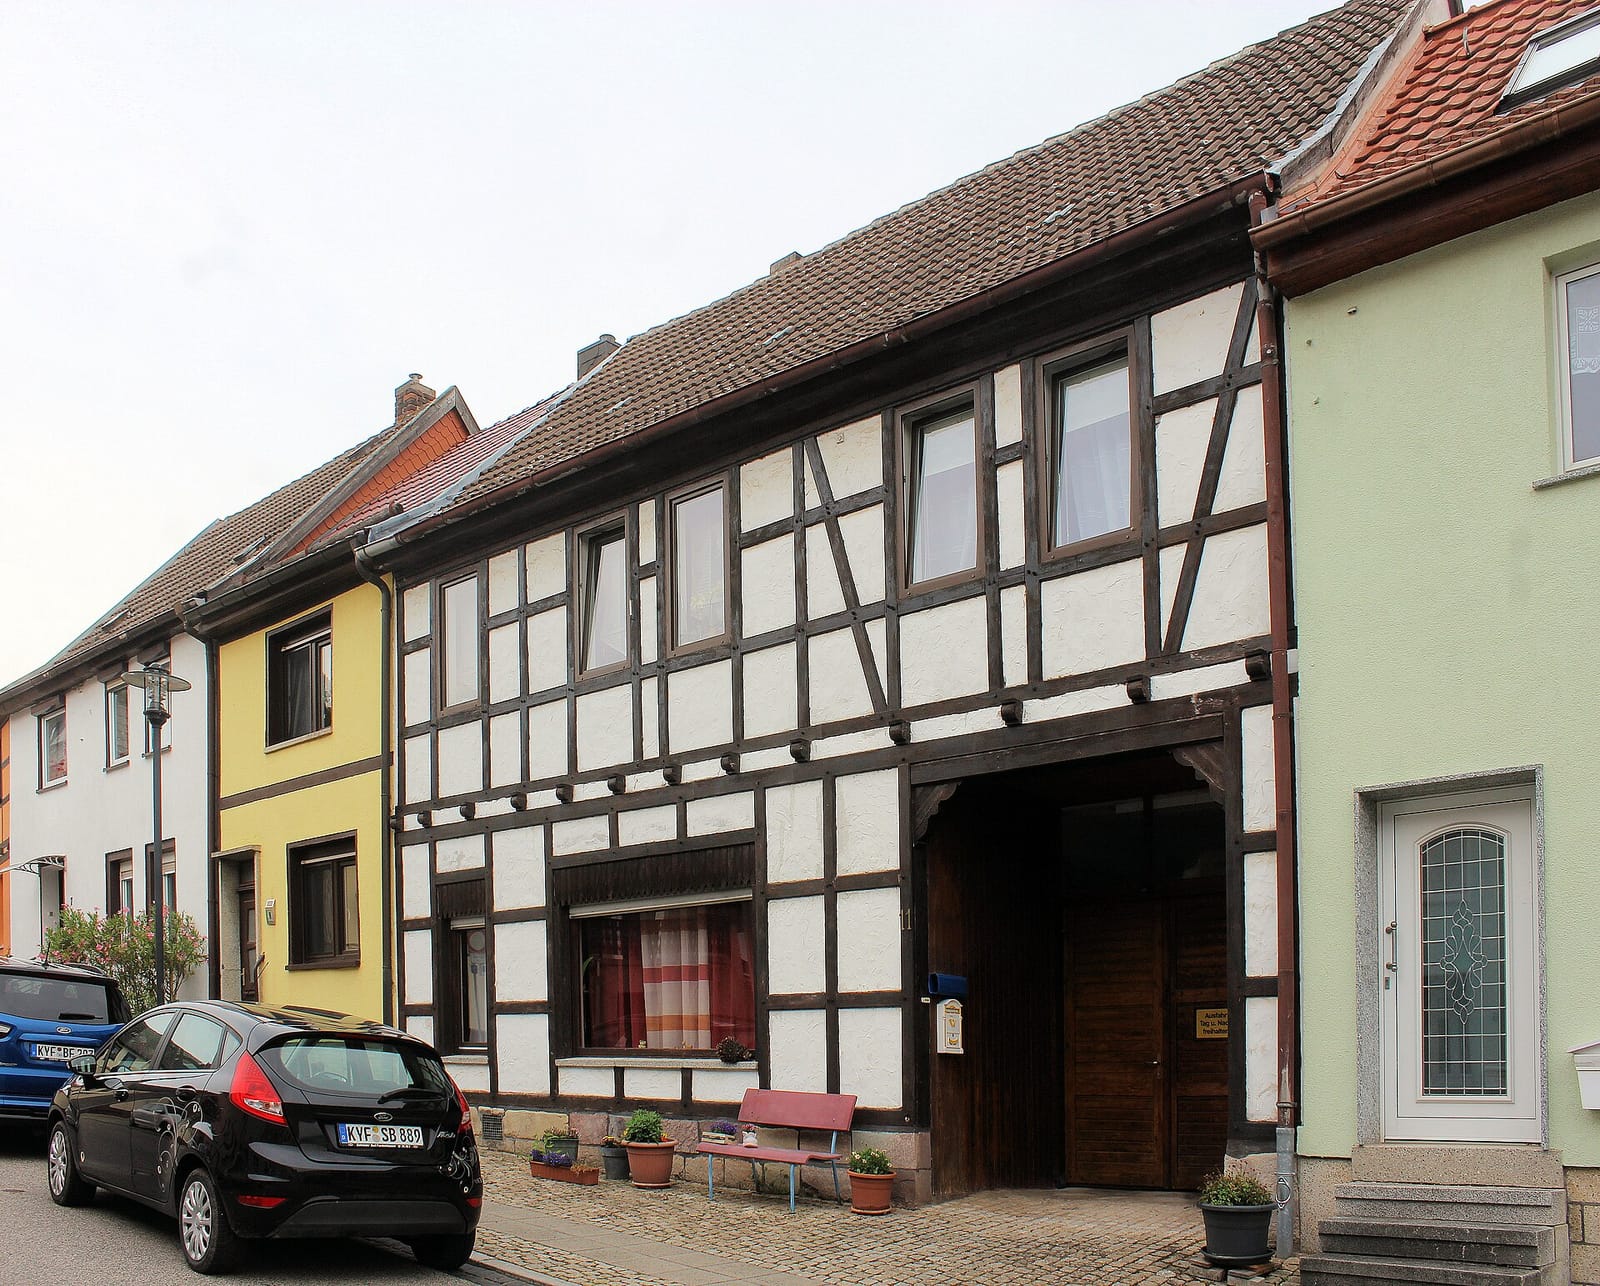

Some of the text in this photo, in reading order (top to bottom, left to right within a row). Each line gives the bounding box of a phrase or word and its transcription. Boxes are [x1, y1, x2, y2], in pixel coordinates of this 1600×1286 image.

[901, 908, 912, 930] 11
[38, 1045, 56, 1057] KYF
[347, 1126, 371, 1142] KYF
[381, 1127, 397, 1142] SB
[399, 1128, 421, 1143] 889
